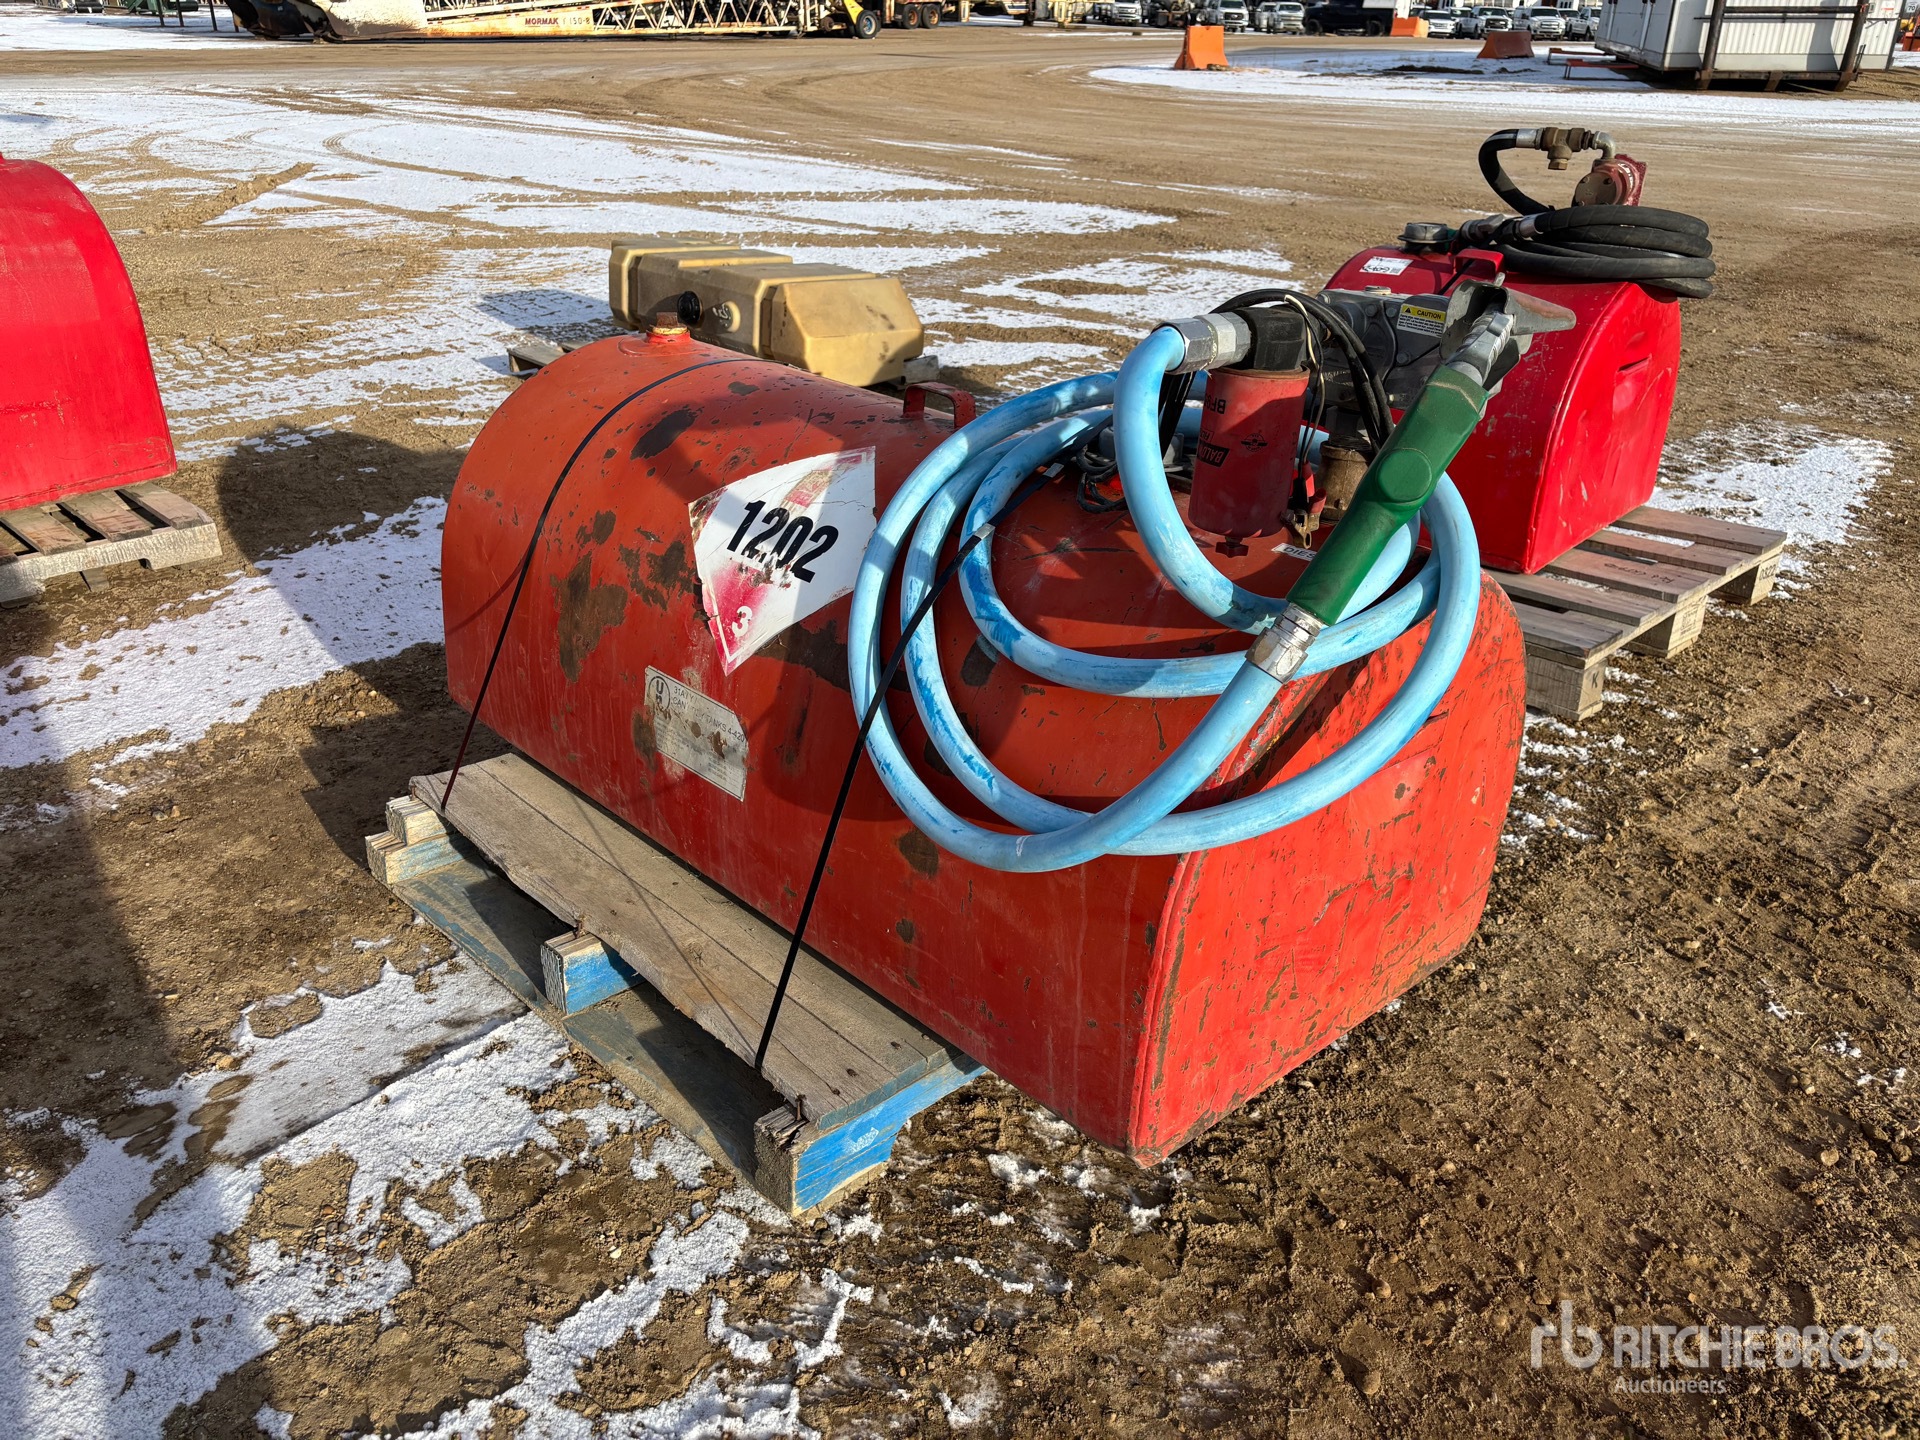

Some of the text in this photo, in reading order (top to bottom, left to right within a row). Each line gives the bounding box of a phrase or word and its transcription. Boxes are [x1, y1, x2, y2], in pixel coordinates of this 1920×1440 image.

[525, 17, 559, 25] MORMAK
[1417, 309, 1442, 320] CAUTION
[726, 499, 839, 584] 1202
[1283, 546, 1316, 559] DIES
[731, 605, 753, 637] 3
